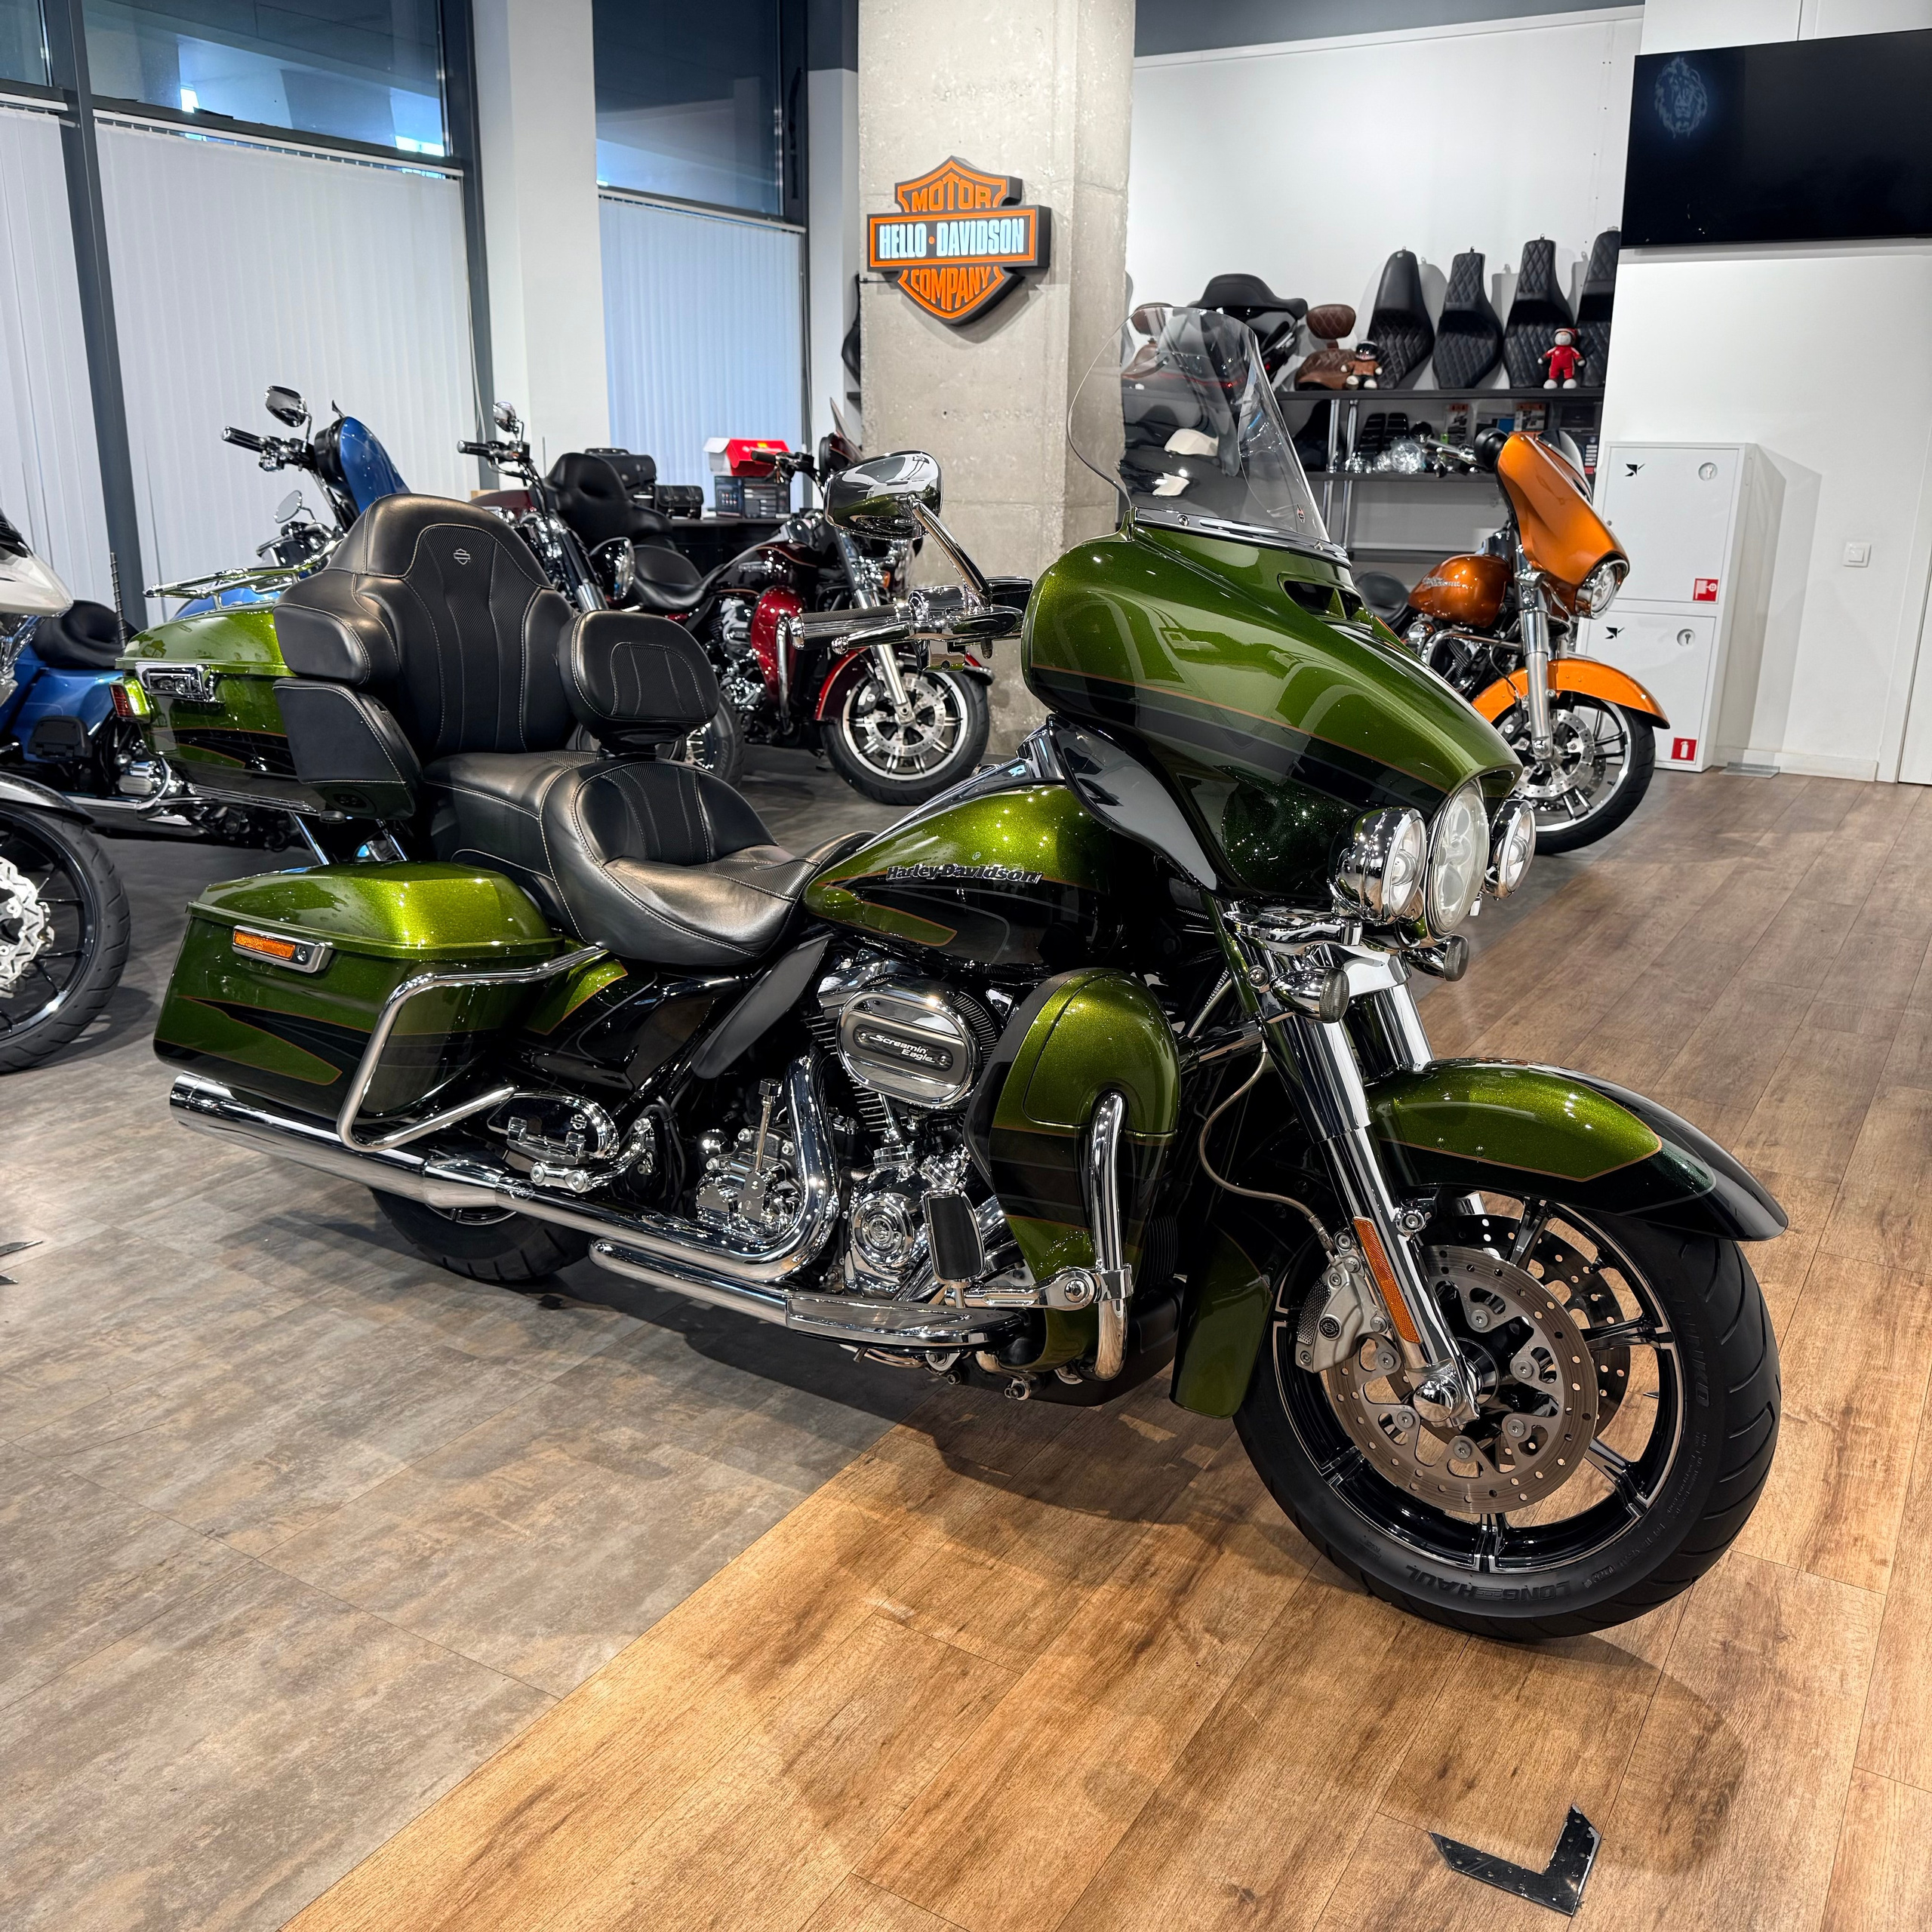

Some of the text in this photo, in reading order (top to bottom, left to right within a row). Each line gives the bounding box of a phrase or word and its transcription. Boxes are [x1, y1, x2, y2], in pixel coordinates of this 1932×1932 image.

[911, 171, 992, 212] MOTOR
[879, 218, 1025, 259] HELLO DAVIDSON
[910, 266, 991, 311] COMPANY
[886, 863, 1043, 884] Harley-Davidson
[901, 1048, 935, 1063] Eagle
[1404, 1564, 1571, 1601] LONG HAUL
